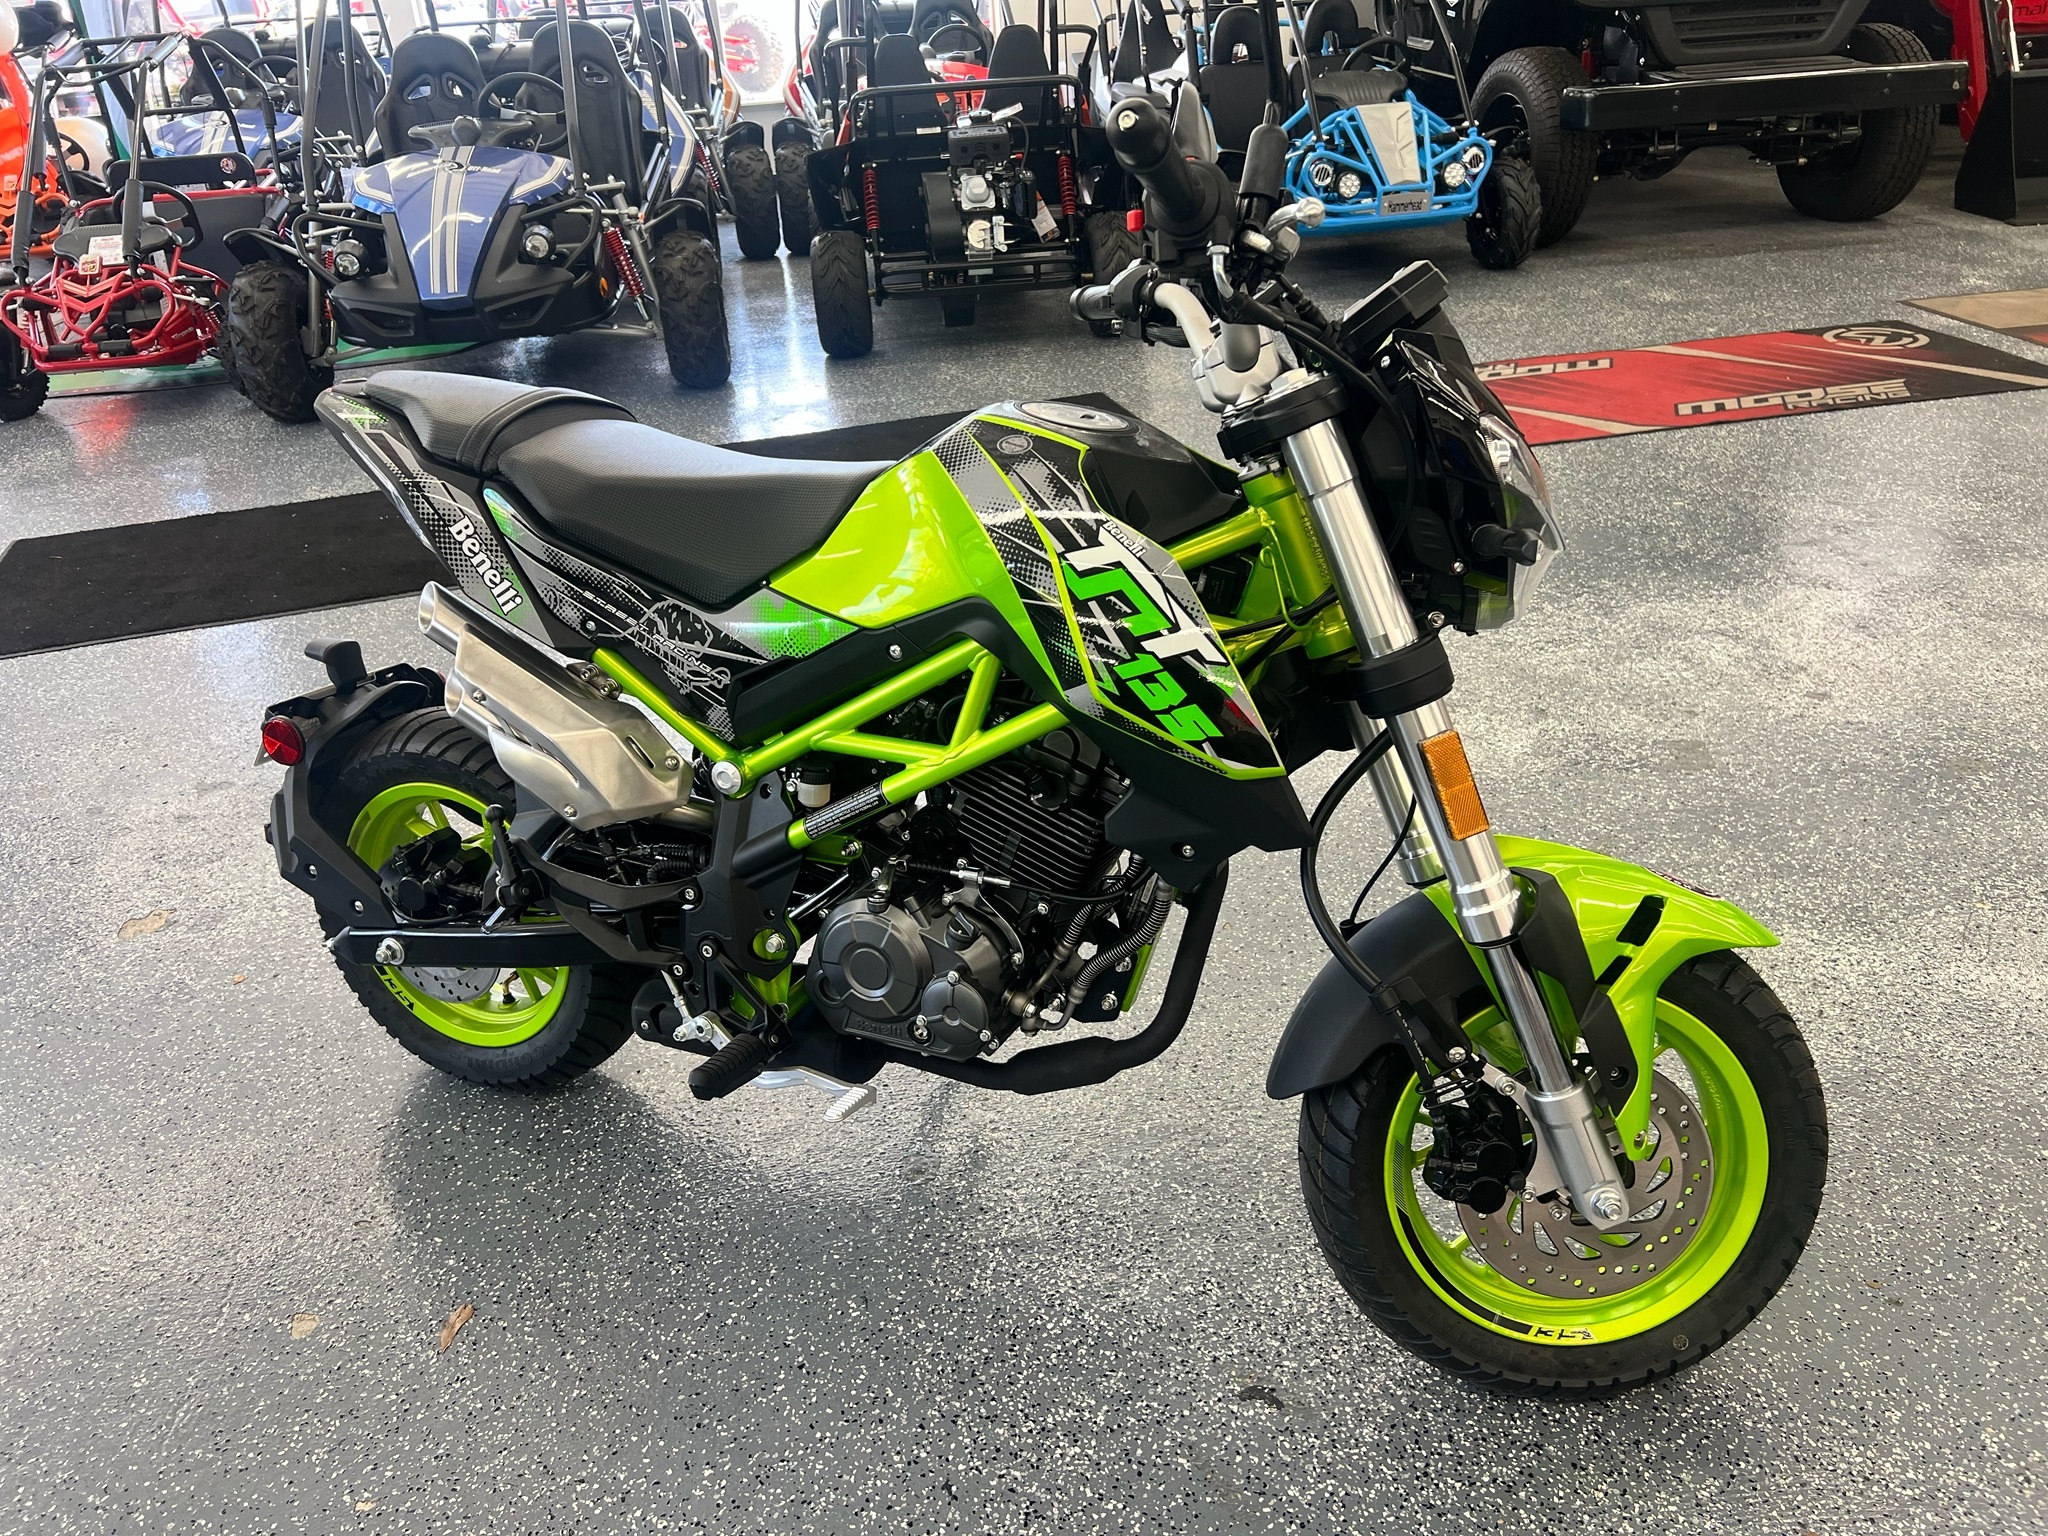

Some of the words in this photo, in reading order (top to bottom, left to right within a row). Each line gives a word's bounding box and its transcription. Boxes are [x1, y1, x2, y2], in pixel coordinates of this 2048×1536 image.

[1676, 378, 1906, 416] MOOSE
[1783, 392, 1912, 411] RACING
[447, 514, 524, 616] Benelli
[1102, 517, 1148, 559] Benelli
[582, 590, 650, 632] STREET
[652, 632, 713, 673] RACING
[1112, 652, 1225, 742] 135
